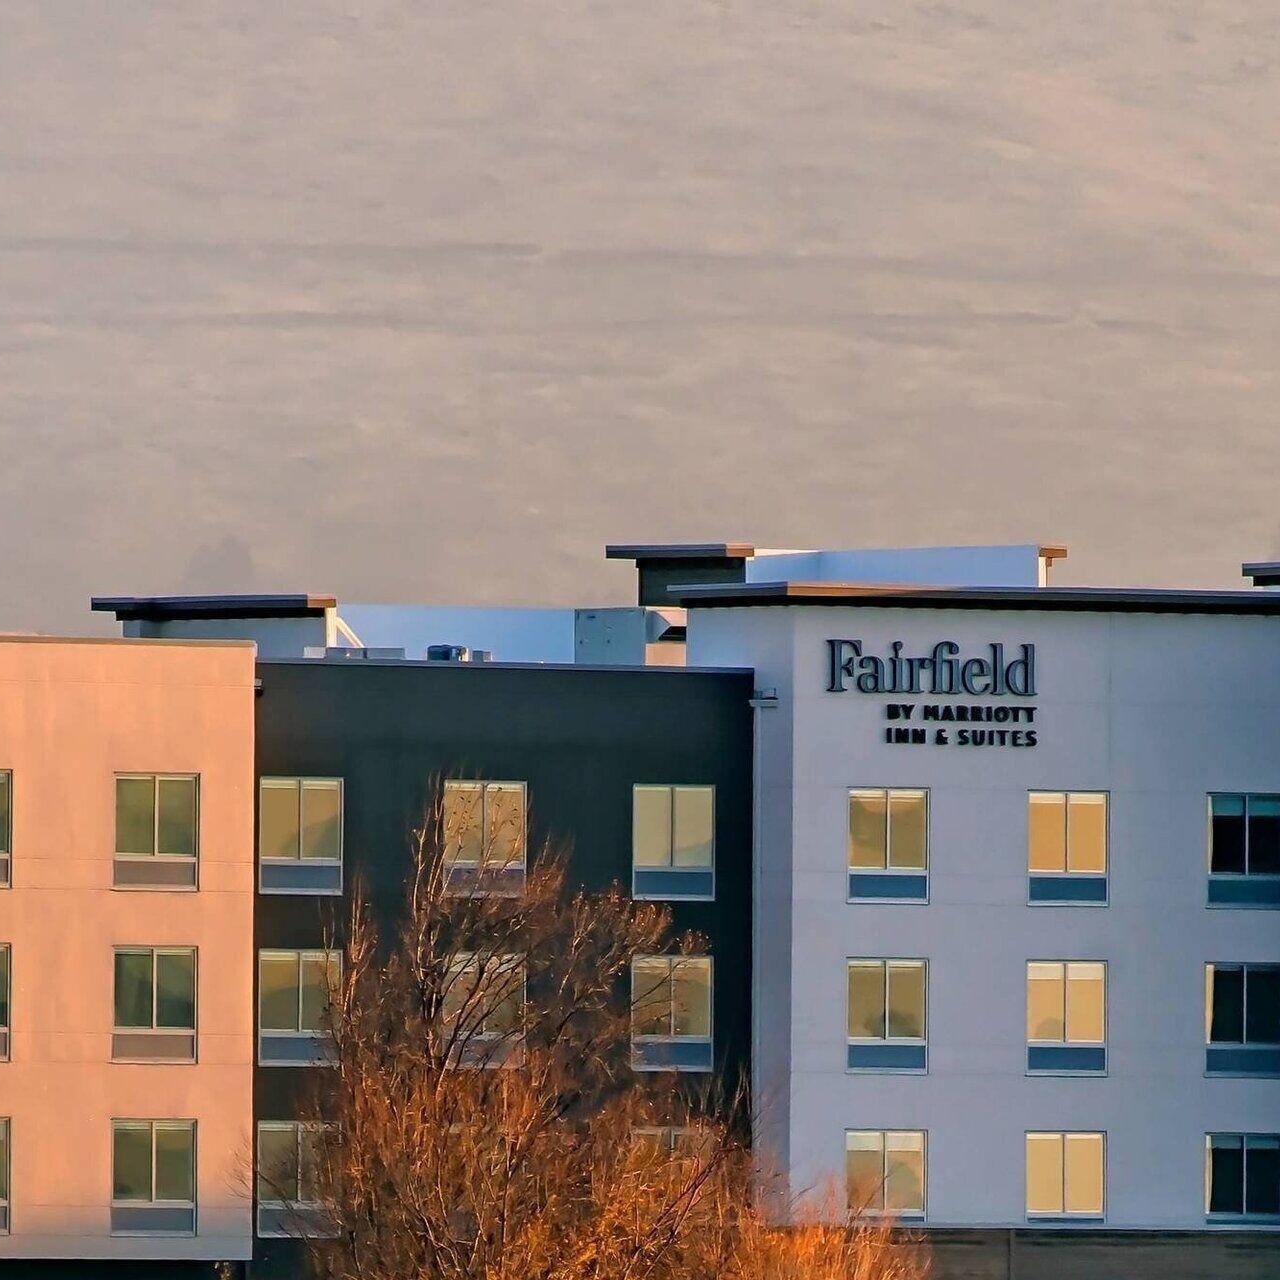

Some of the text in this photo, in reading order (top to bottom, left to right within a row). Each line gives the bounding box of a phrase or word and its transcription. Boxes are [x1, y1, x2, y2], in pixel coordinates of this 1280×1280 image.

[825, 639, 1038, 696] Fairfield
[886, 704, 1038, 723] BY MARRIOTT
[886, 728, 1038, 746] INN & SUITES
